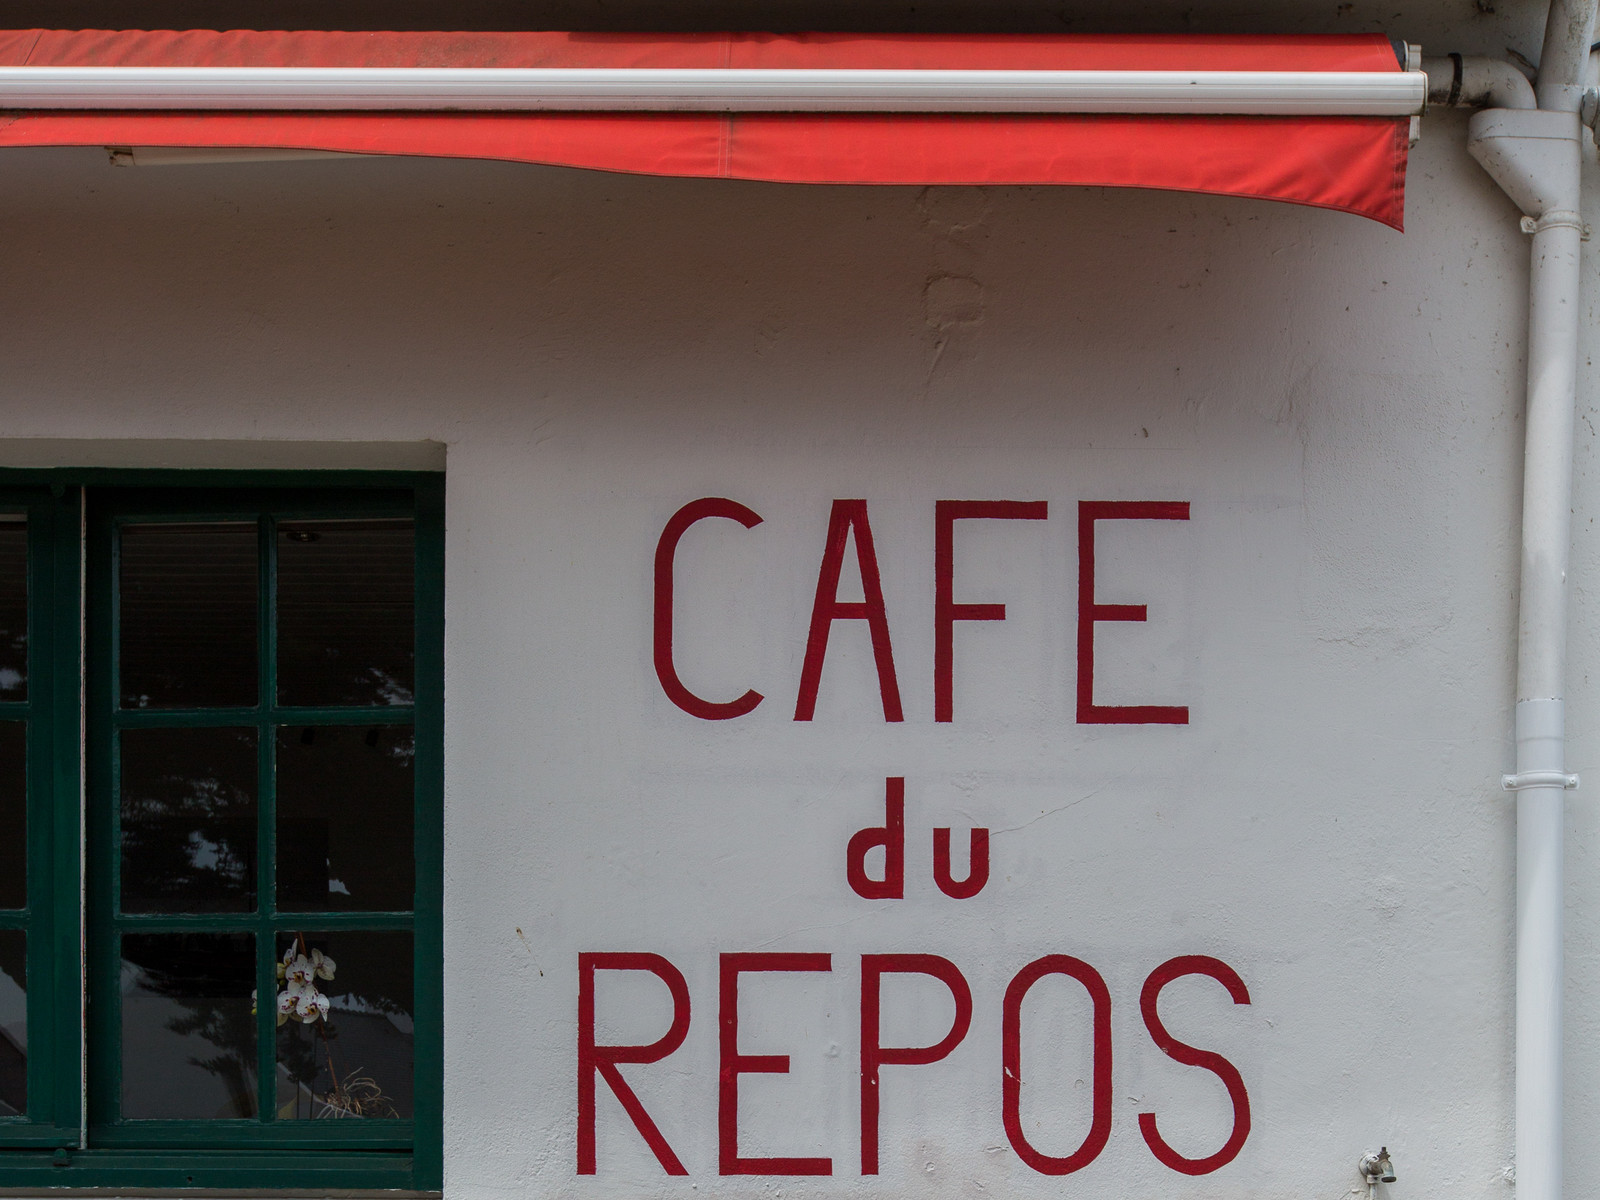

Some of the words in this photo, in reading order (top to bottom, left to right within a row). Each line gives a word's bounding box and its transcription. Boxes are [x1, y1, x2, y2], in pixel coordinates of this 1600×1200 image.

[654, 497, 1190, 724] CAFE
[847, 777, 989, 899] du
[577, 952, 1250, 1175] REPOS
